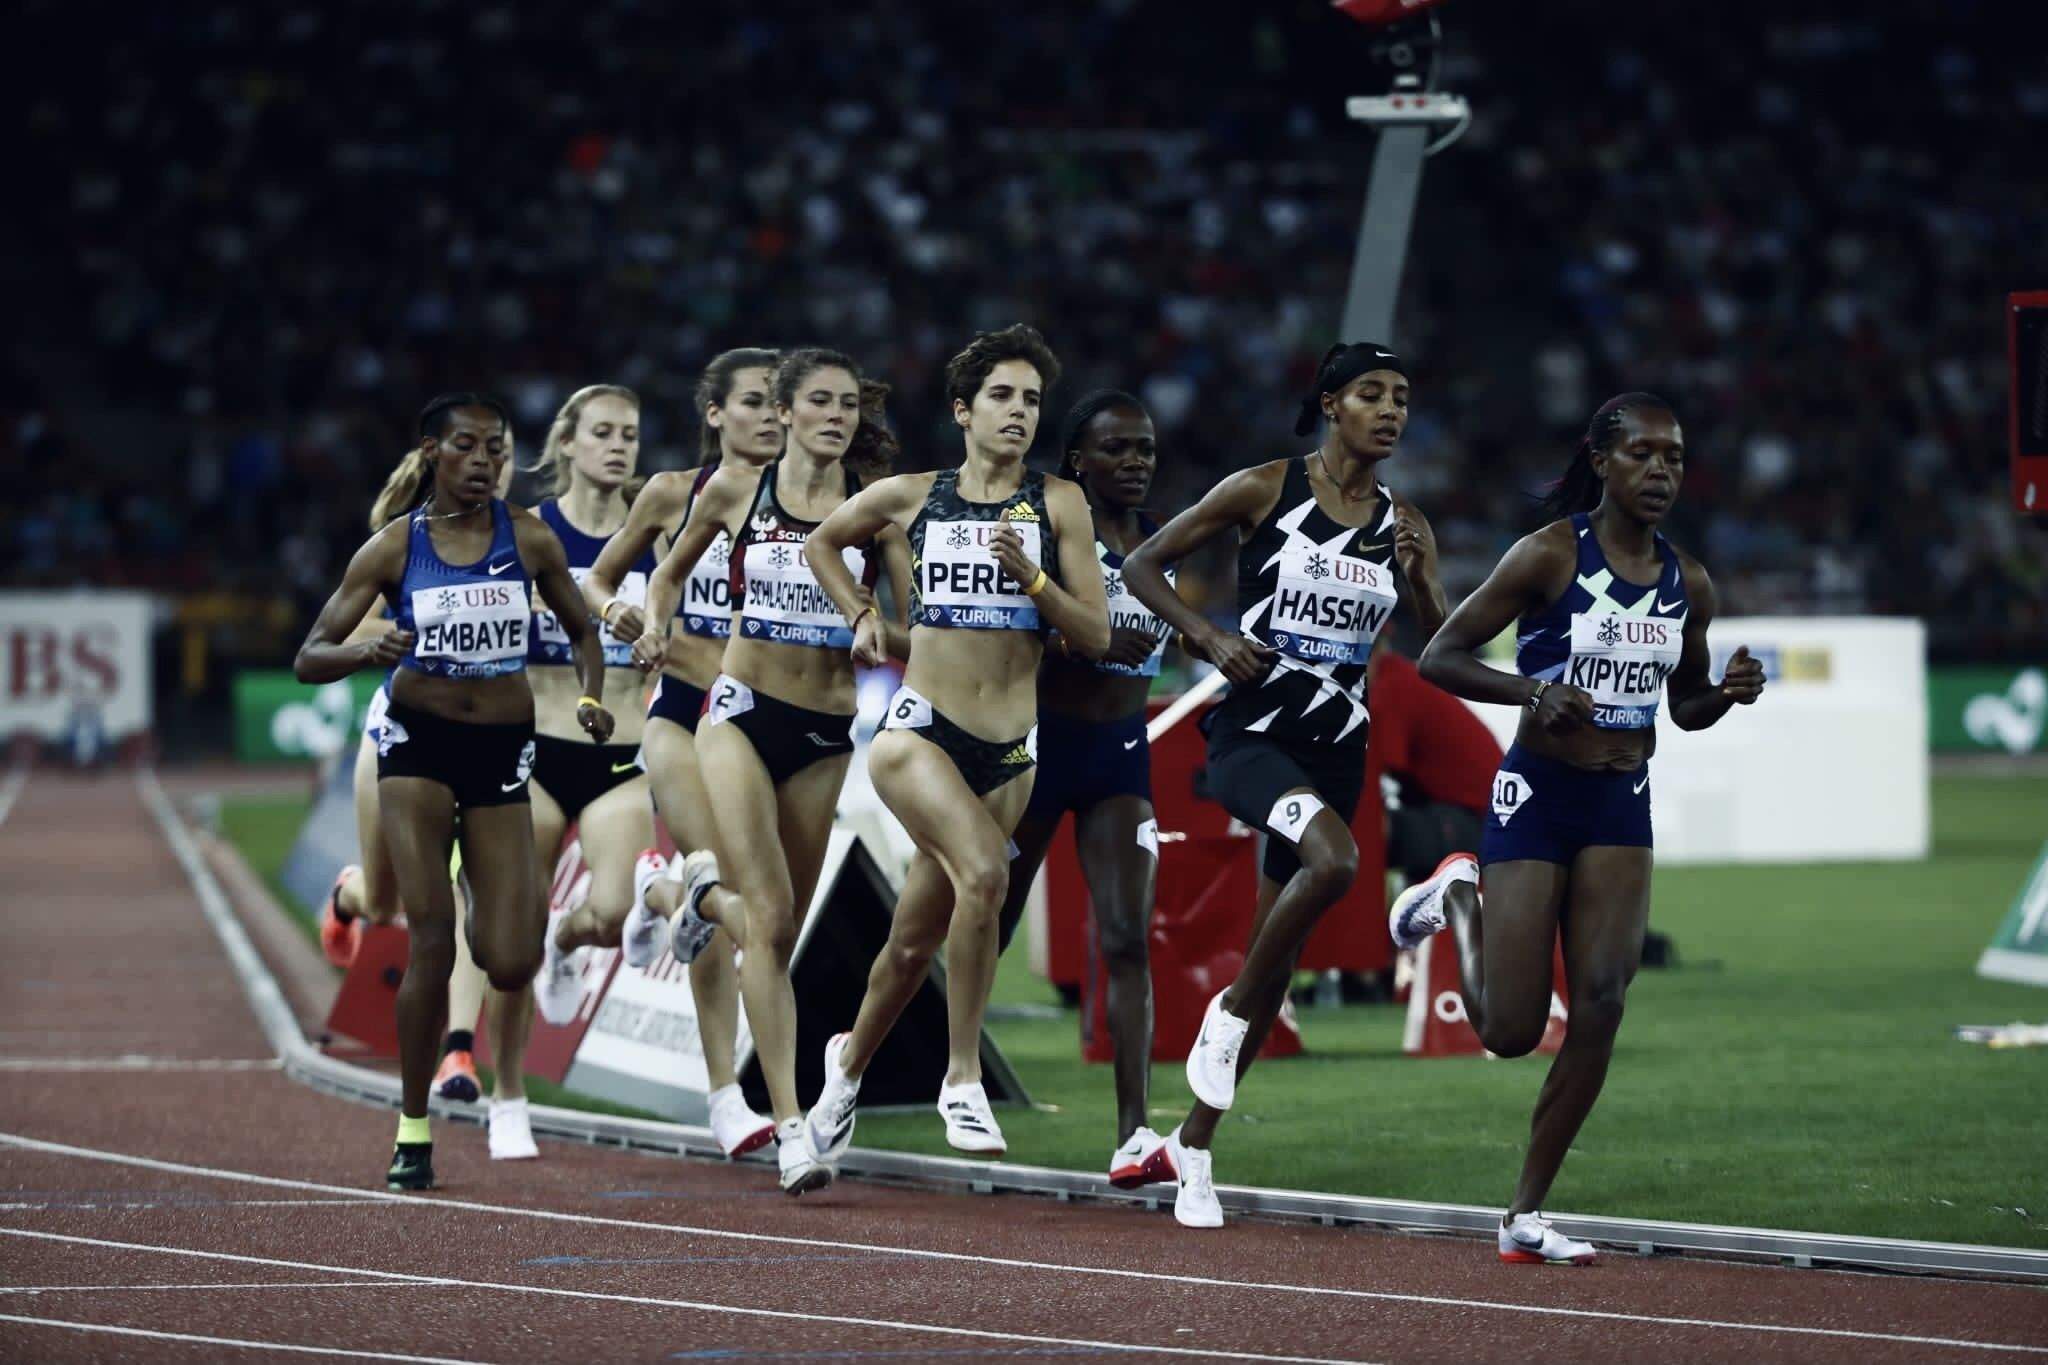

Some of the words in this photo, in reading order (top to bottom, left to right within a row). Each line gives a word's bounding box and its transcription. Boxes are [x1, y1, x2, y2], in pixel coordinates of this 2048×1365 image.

[928, 562, 1030, 596] PERE
[1335, 560, 1377, 588] UBS
[464, 586, 510, 608] UBS
[750, 579, 842, 616] SCHLACHTENHAU
[951, 608, 1011, 625] ZURICH
[1278, 588, 1388, 633] HASSAN
[423, 619, 523, 652] EMBAYE
[769, 624, 828, 642] ZURICH
[1626, 621, 1668, 645] UBS
[1298, 639, 1355, 661] ZURICH
[447, 662, 501, 677] ZURICH
[716, 684, 737, 709] 2
[895, 698, 917, 720] 6
[1593, 707, 1647, 725] ZURICH
[1495, 778, 1518, 807] 10
[1286, 801, 1302, 825] 9
